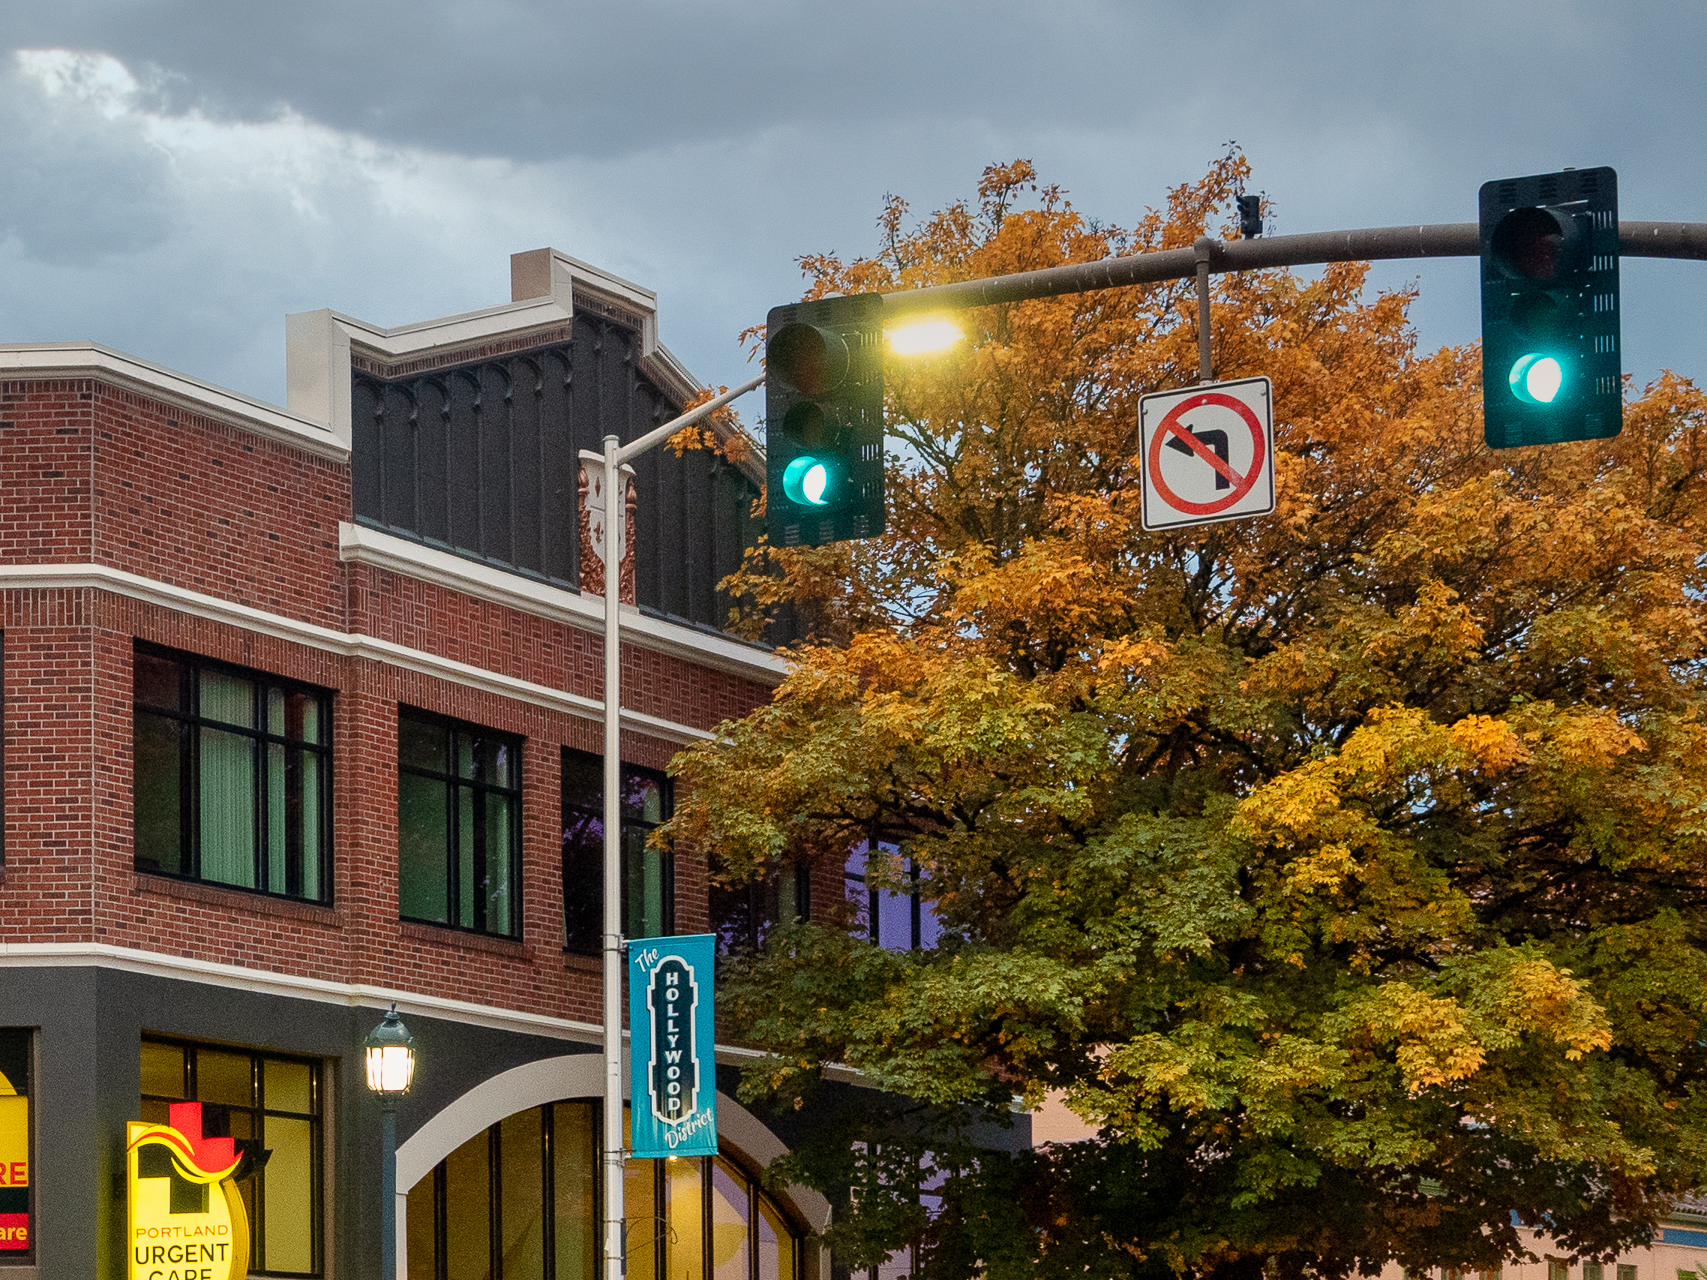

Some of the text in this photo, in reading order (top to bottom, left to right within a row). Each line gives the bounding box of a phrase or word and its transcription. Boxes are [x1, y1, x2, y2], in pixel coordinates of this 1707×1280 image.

[634, 947, 660, 973] The
[664, 971, 683, 1112] HOLLYWOOD
[664, 1107, 714, 1149] District
[135, 1224, 229, 1239] PORTLAND
[135, 1243, 229, 1265] URGENT
